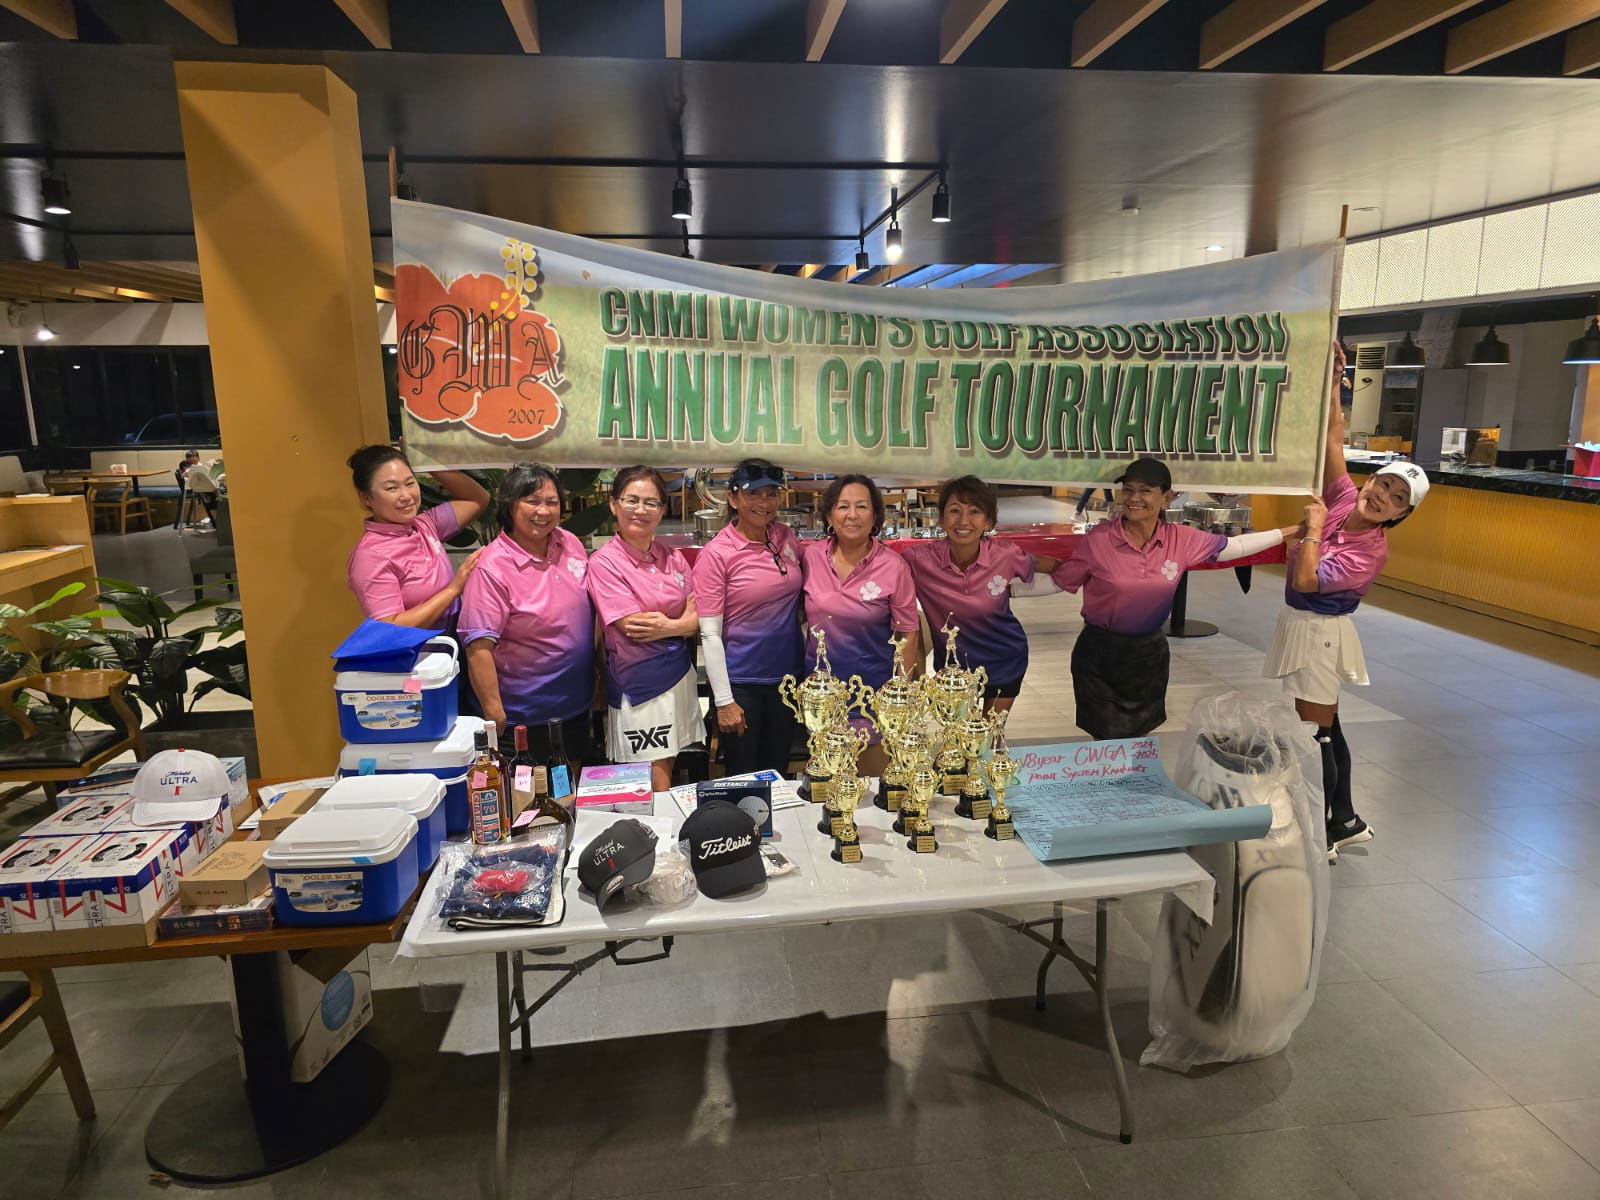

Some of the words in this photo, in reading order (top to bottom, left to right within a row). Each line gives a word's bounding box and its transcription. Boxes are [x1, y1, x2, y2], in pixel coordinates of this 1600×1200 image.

[600, 286, 710, 341] CNMI
[718, 294, 915, 350] WOMEN'S
[921, 318, 1019, 351] GOLF
[1026, 310, 1288, 355] ASSOCIATION
[597, 345, 804, 447] ANNUAL
[815, 354, 941, 450] GOLF
[949, 359, 1290, 456] TOURNAMENT
[507, 408, 546, 425] 2007
[623, 724, 673, 754] PXG
[1074, 744, 1126, 766] CWGA
[160, 776, 199, 786] ULTRA
[483, 804, 496, 815] 70
[593, 841, 625, 866] ULTRA
[698, 834, 752, 860] Titleist
